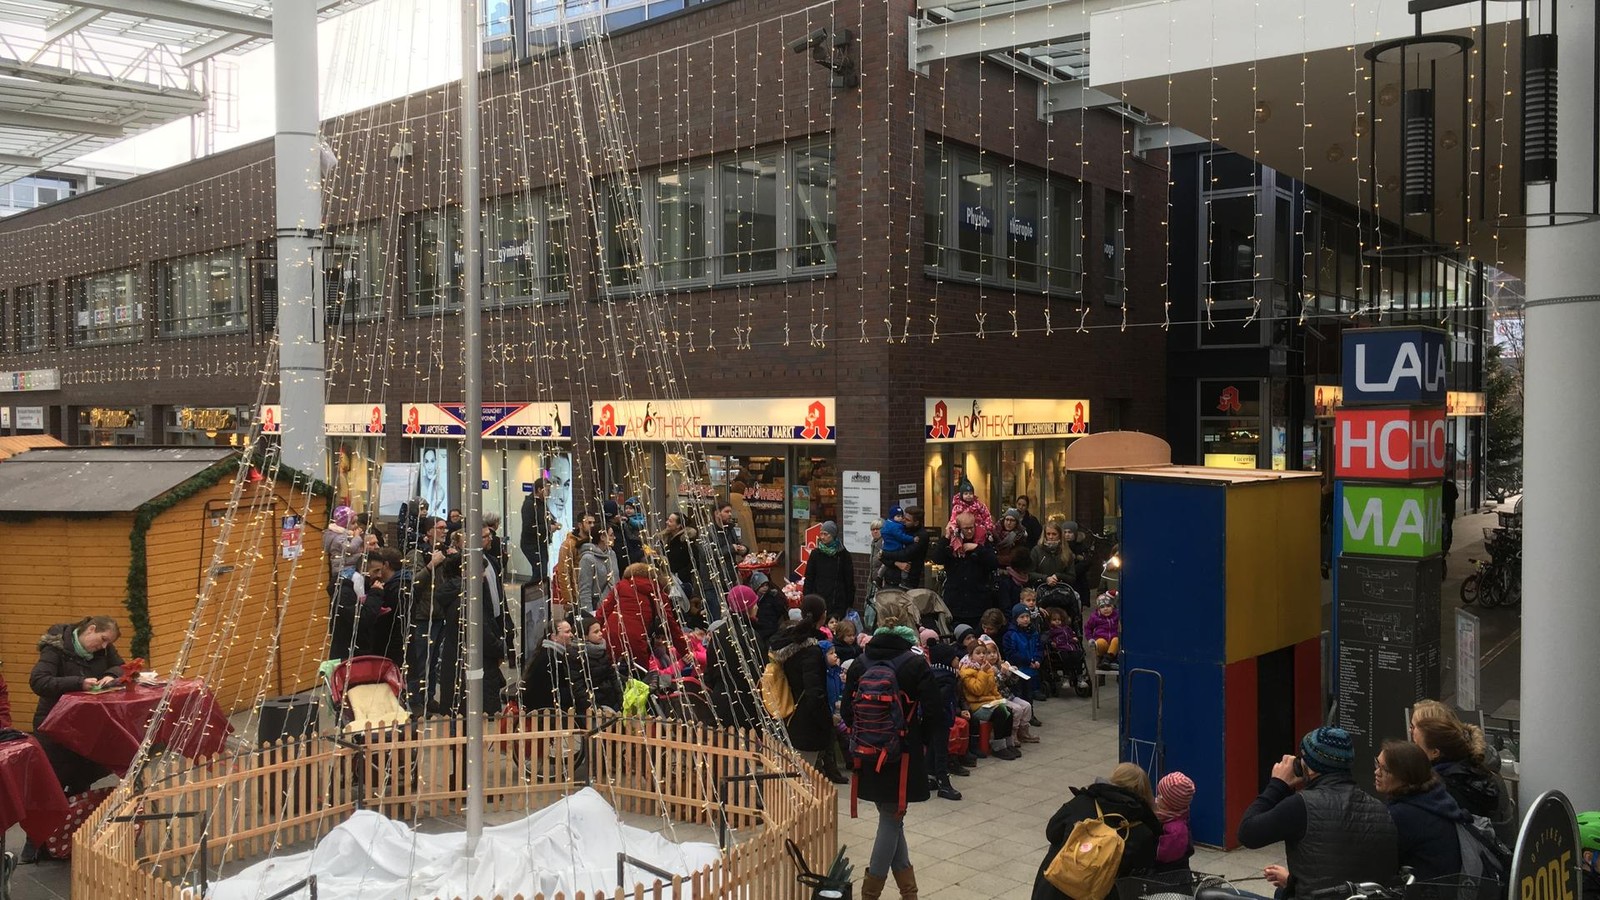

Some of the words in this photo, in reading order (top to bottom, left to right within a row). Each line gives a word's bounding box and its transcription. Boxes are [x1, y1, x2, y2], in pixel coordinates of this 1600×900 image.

[966, 207, 990, 230] Physio-
[1009, 217, 1033, 240] therapie
[1355, 341, 1422, 392] LA
[426, 425, 449, 435] APOTHEKE
[516, 426, 542, 436] APOTHEKE
[626, 416, 701, 438] APOTHEKE
[706, 427, 717, 438] AM
[718, 426, 770, 438] LANGENHORNER
[771, 425, 796, 438] MARKT
[955, 415, 1013, 438] APOTHEKE
[1016, 424, 1024, 435] AM
